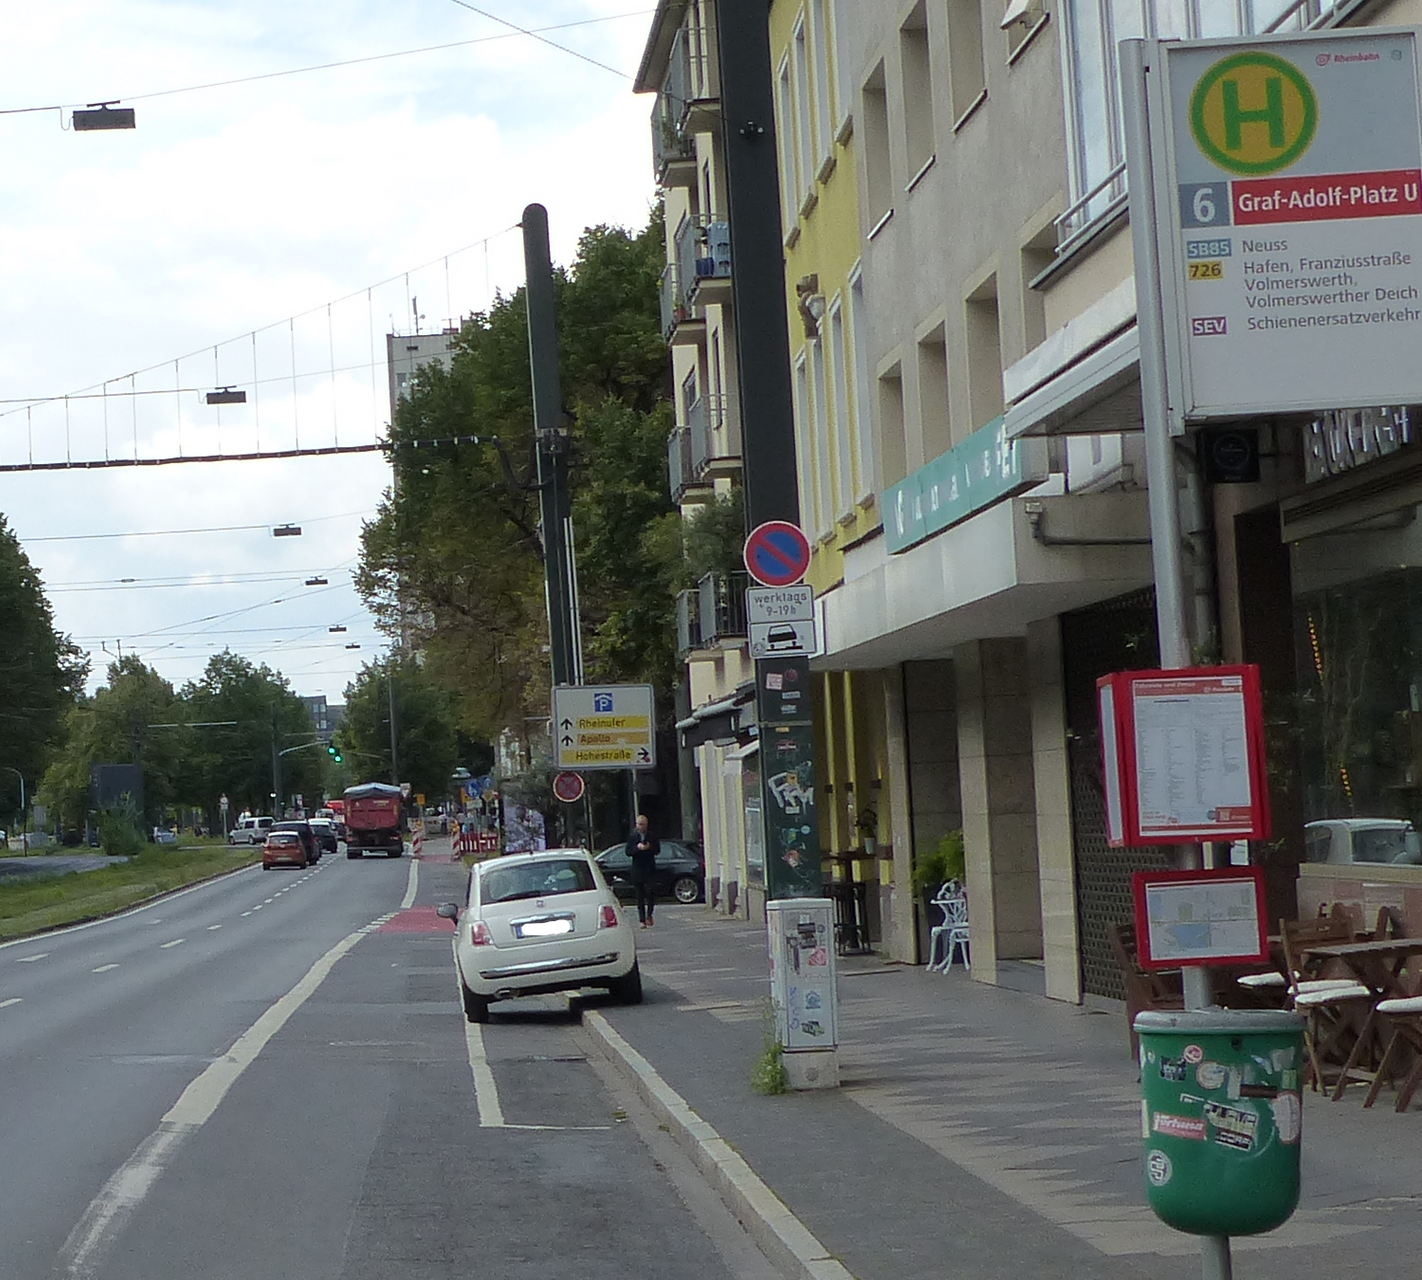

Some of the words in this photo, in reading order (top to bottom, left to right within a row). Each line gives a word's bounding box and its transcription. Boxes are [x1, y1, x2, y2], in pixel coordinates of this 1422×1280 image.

[1221, 76, 1285, 150] H
[1193, 187, 1216, 223] 6
[1238, 185, 1398, 212] Graf-Adolf-Platz
[1404, 182, 1418, 202] U
[1187, 241, 1230, 258] SB85
[1242, 239, 1289, 253] Neuss
[1189, 263, 1222, 278] 726
[1243, 259, 1295, 275] Hafen,
[1299, 251, 1412, 271] Franziusstraße
[1245, 272, 1358, 292] Volmerswerth,
[1246, 290, 1370, 309] Volmerswerther
[1375, 285, 1418, 301] Deich
[1193, 318, 1226, 334] SEV
[1248, 308, 1421, 331] Schienenersatzverkehr
[580, 734, 611, 744] Apollo
